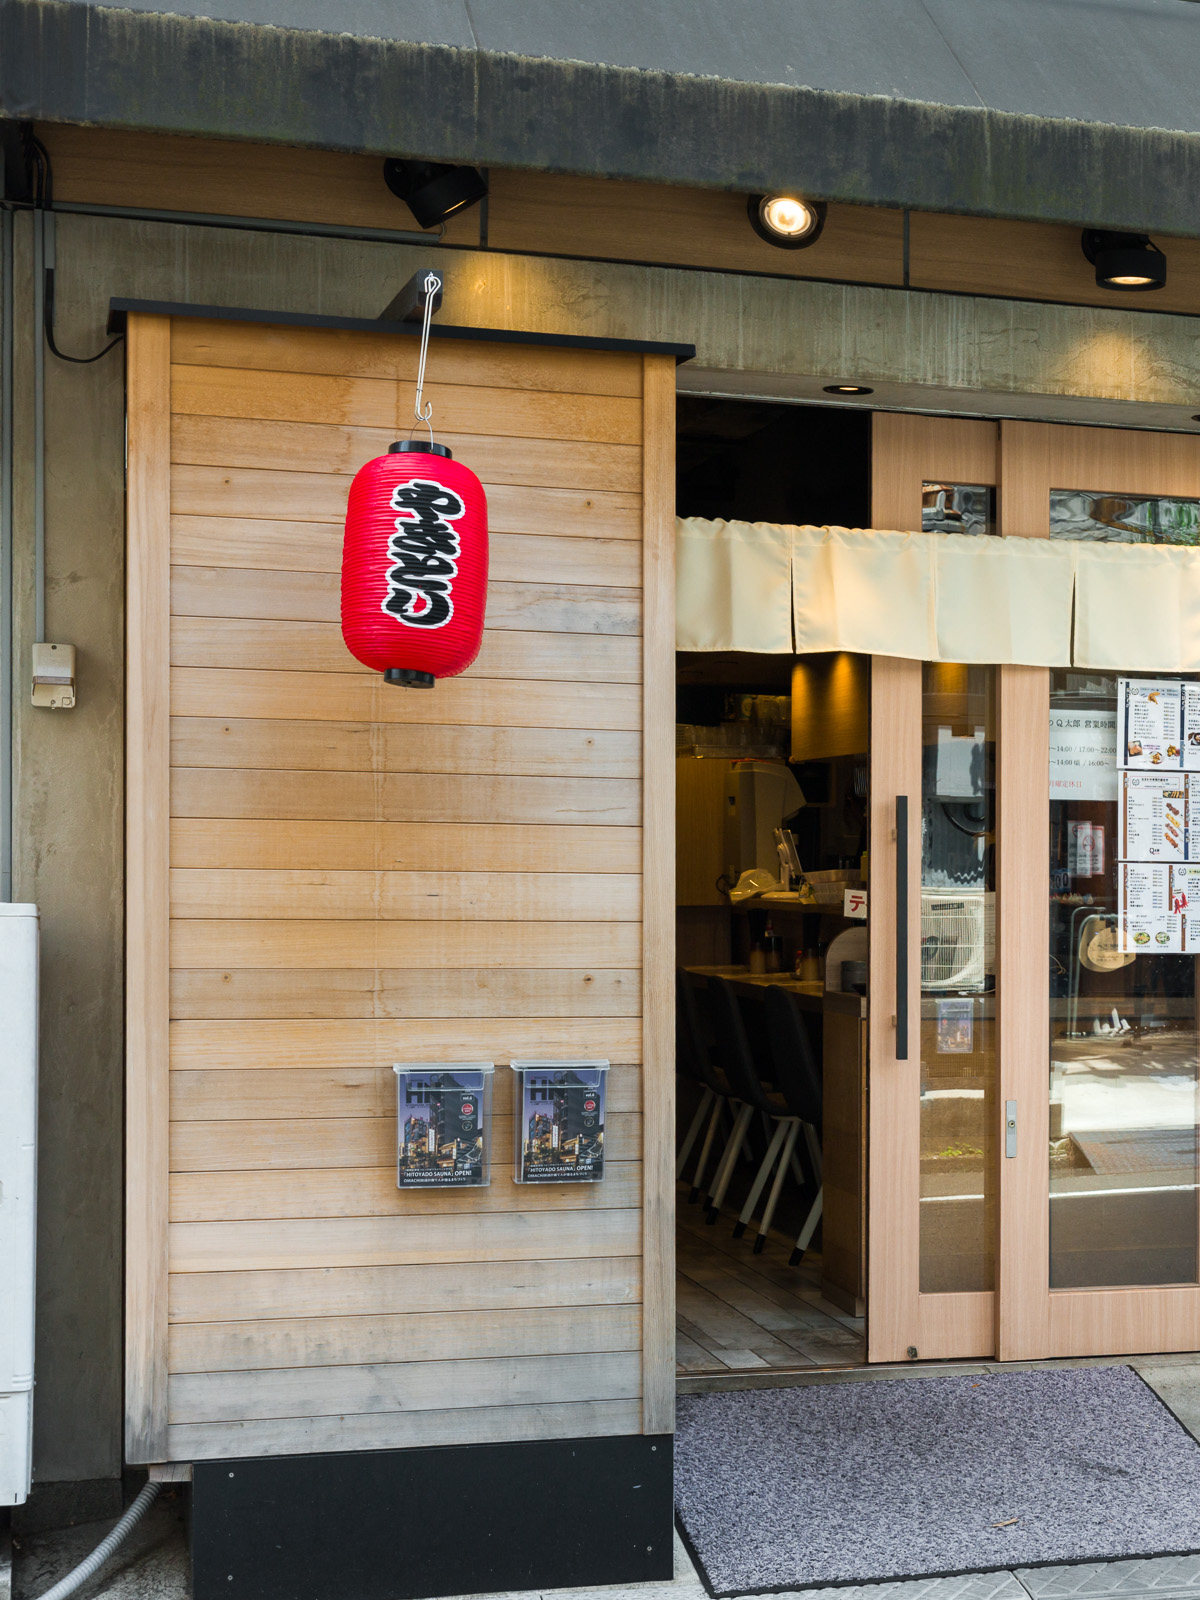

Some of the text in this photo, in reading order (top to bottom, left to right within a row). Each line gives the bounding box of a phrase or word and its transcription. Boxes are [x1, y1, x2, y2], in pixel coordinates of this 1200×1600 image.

[381, 479, 465, 629] やきとり
[1084, 720, 1116, 729] 営業時間
[849, 895, 868, 912] テ
